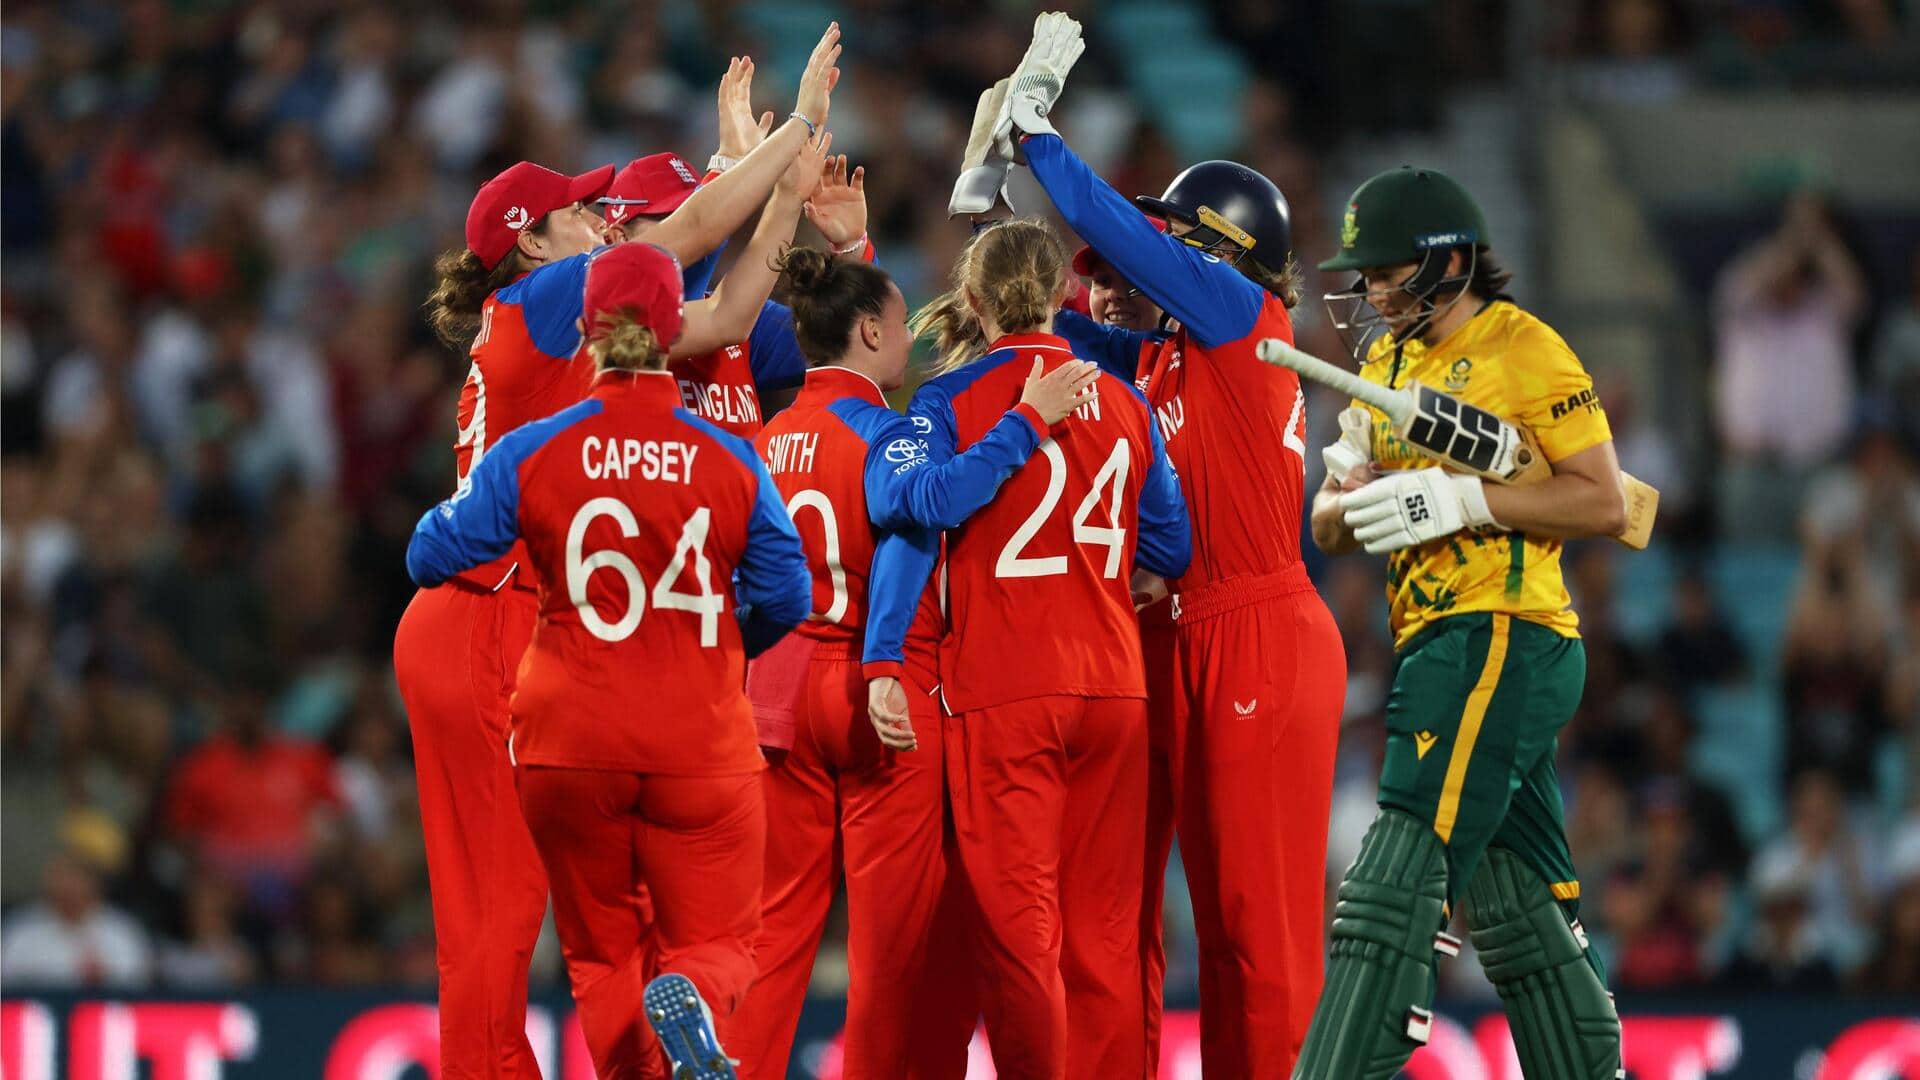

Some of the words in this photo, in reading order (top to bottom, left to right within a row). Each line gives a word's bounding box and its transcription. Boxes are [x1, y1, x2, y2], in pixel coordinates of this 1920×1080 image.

[582, 436, 698, 484] CAPSEY
[765, 432, 819, 474] SMITH
[995, 437, 1130, 579] 24
[566, 497, 724, 647] 64
